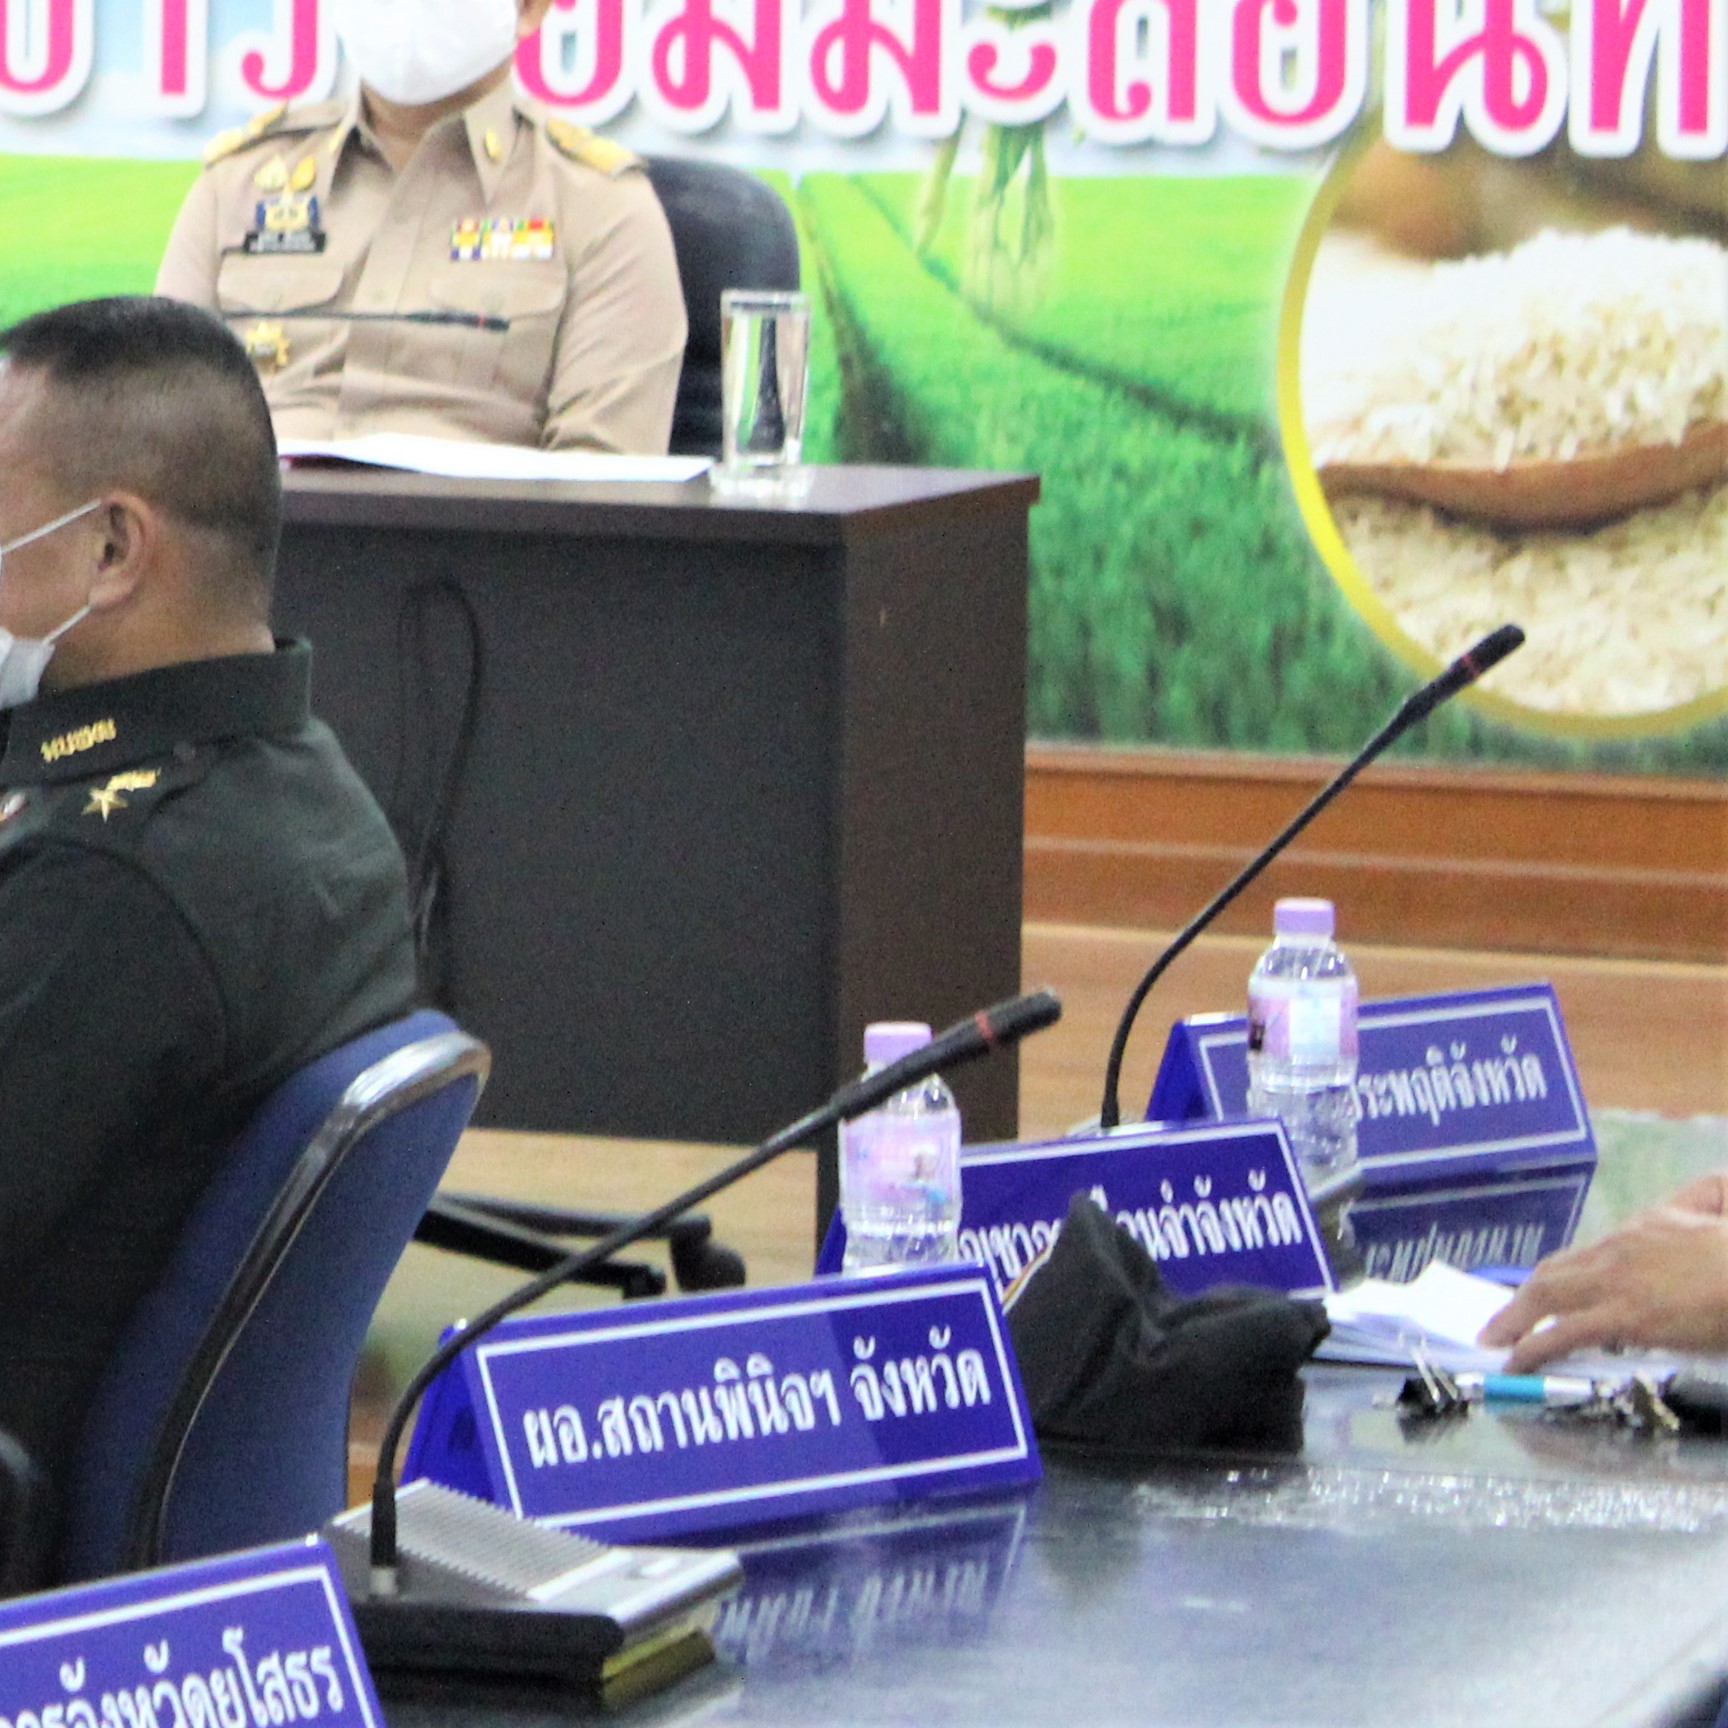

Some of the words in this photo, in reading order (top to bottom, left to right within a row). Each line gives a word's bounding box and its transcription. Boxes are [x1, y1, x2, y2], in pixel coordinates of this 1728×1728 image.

[523, 1351, 842, 1469] ผอ.สถานพินิจฯ
[849, 1325, 992, 1423] จังหวัด
